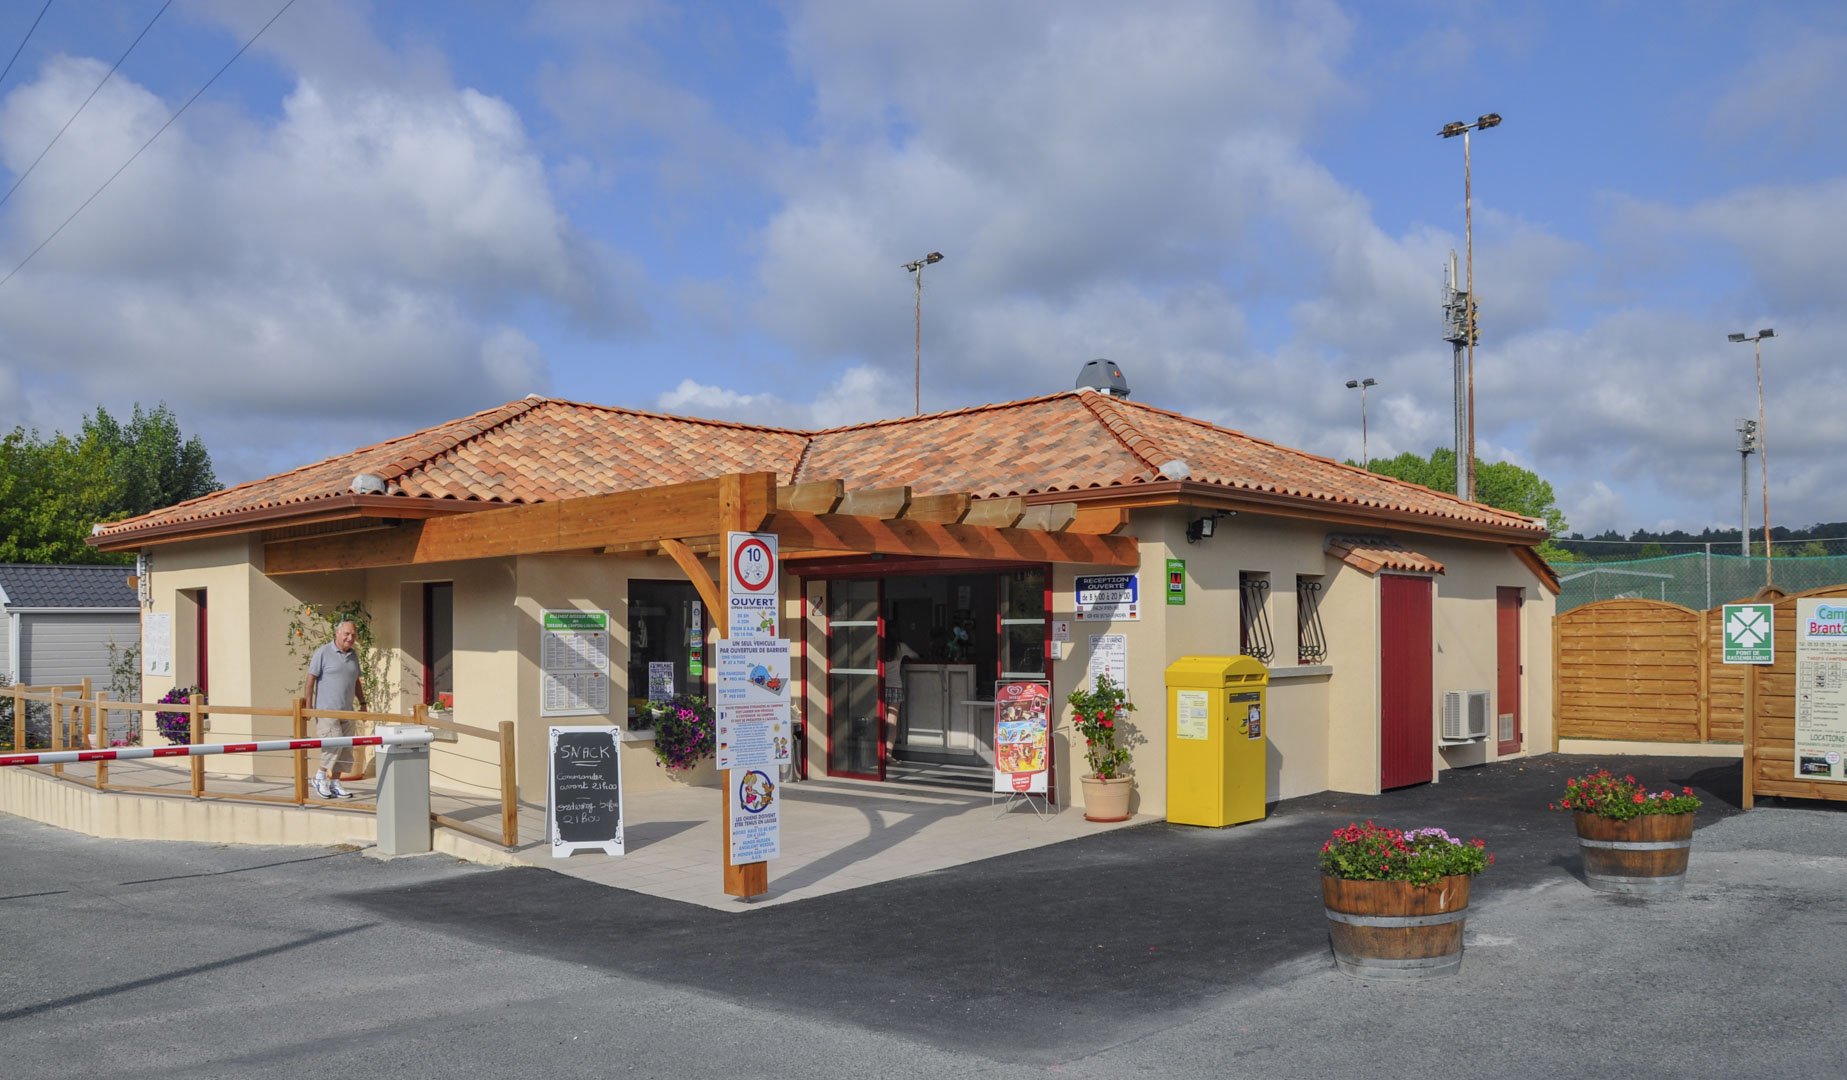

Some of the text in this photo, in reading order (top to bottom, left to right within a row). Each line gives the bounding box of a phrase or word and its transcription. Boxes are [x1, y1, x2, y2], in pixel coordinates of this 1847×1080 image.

[747, 548, 761, 562] 10
[1099, 592, 1105, 601] 00
[1112, 592, 1118, 600] 20
[1124, 592, 1130, 600] 00
[732, 598, 774, 606] OUVERT
[1810, 734, 1845, 742] LOCATIONS
[560, 745, 610, 759] SNACK
[560, 781, 588, 790] avant
